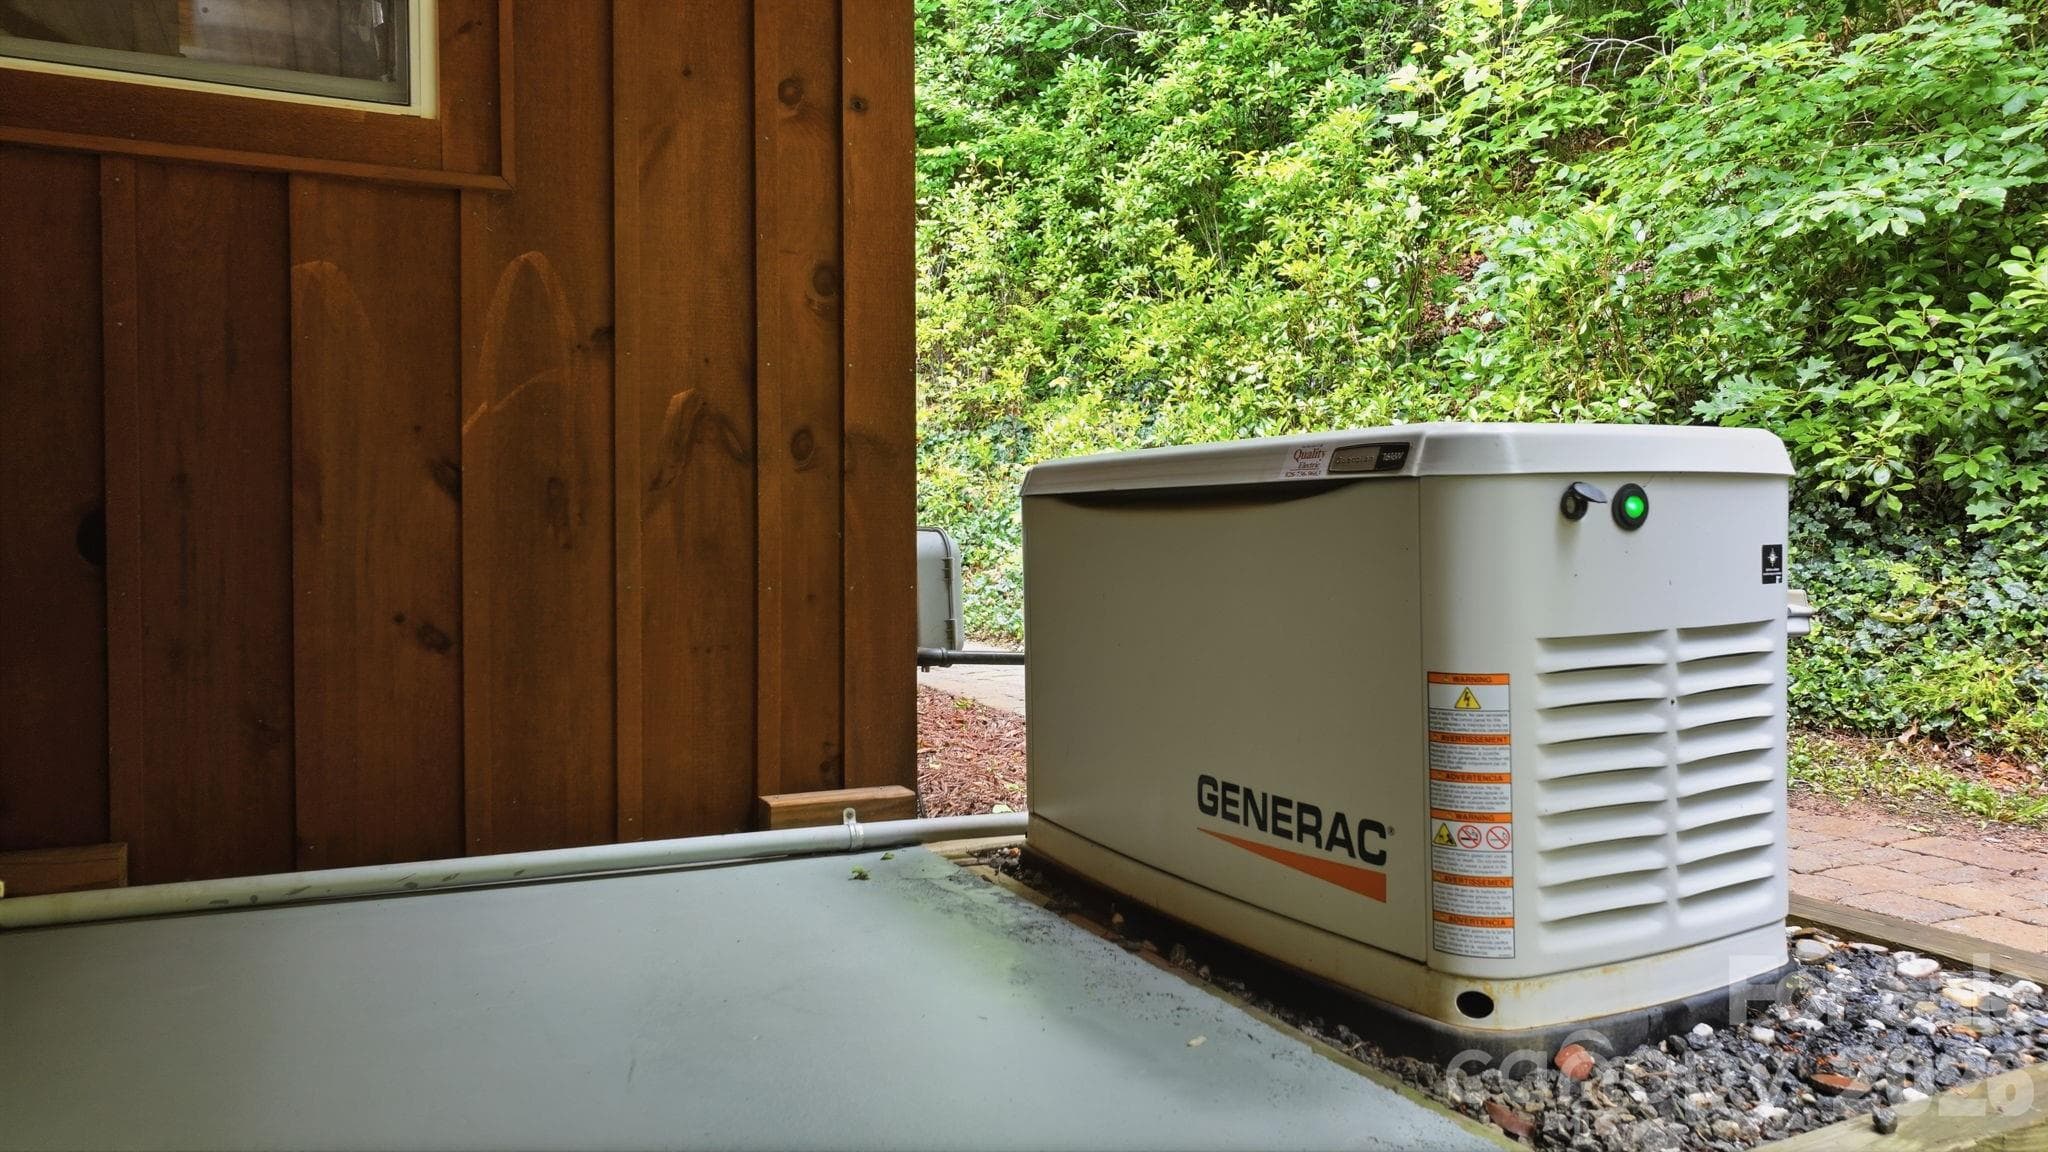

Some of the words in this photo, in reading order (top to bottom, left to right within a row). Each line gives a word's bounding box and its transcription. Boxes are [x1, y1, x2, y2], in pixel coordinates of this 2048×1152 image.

[1293, 447, 1328, 462] Quality
[1452, 676, 1493, 684] WARNING
[1446, 773, 1504, 782] ADVERTENCIA
[1197, 774, 1387, 866] GENERAC
[1455, 813, 1495, 822] WARNING
